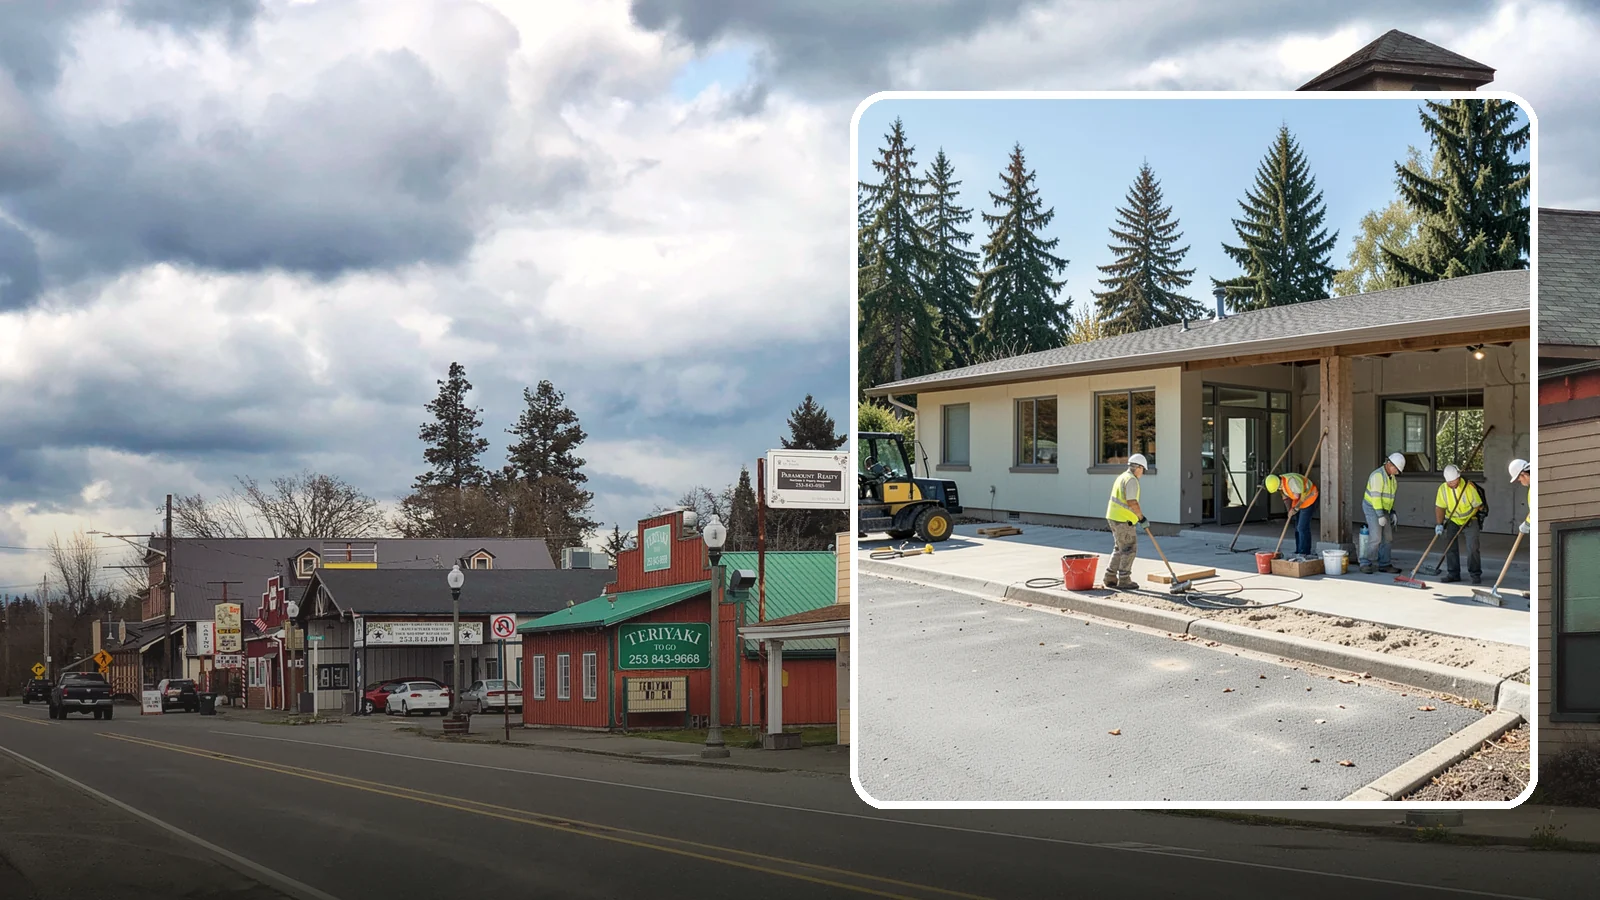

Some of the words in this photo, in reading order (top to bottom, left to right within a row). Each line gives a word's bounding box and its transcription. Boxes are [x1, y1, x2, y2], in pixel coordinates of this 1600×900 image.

[781, 471, 815, 479] PARAMOUNT
[817, 472, 839, 480] REALTY
[624, 628, 702, 646] TERIYAKI
[629, 654, 648, 664] 253
[652, 654, 700, 664] 843-9668
[639, 681, 672, 690] TERIYAKI
